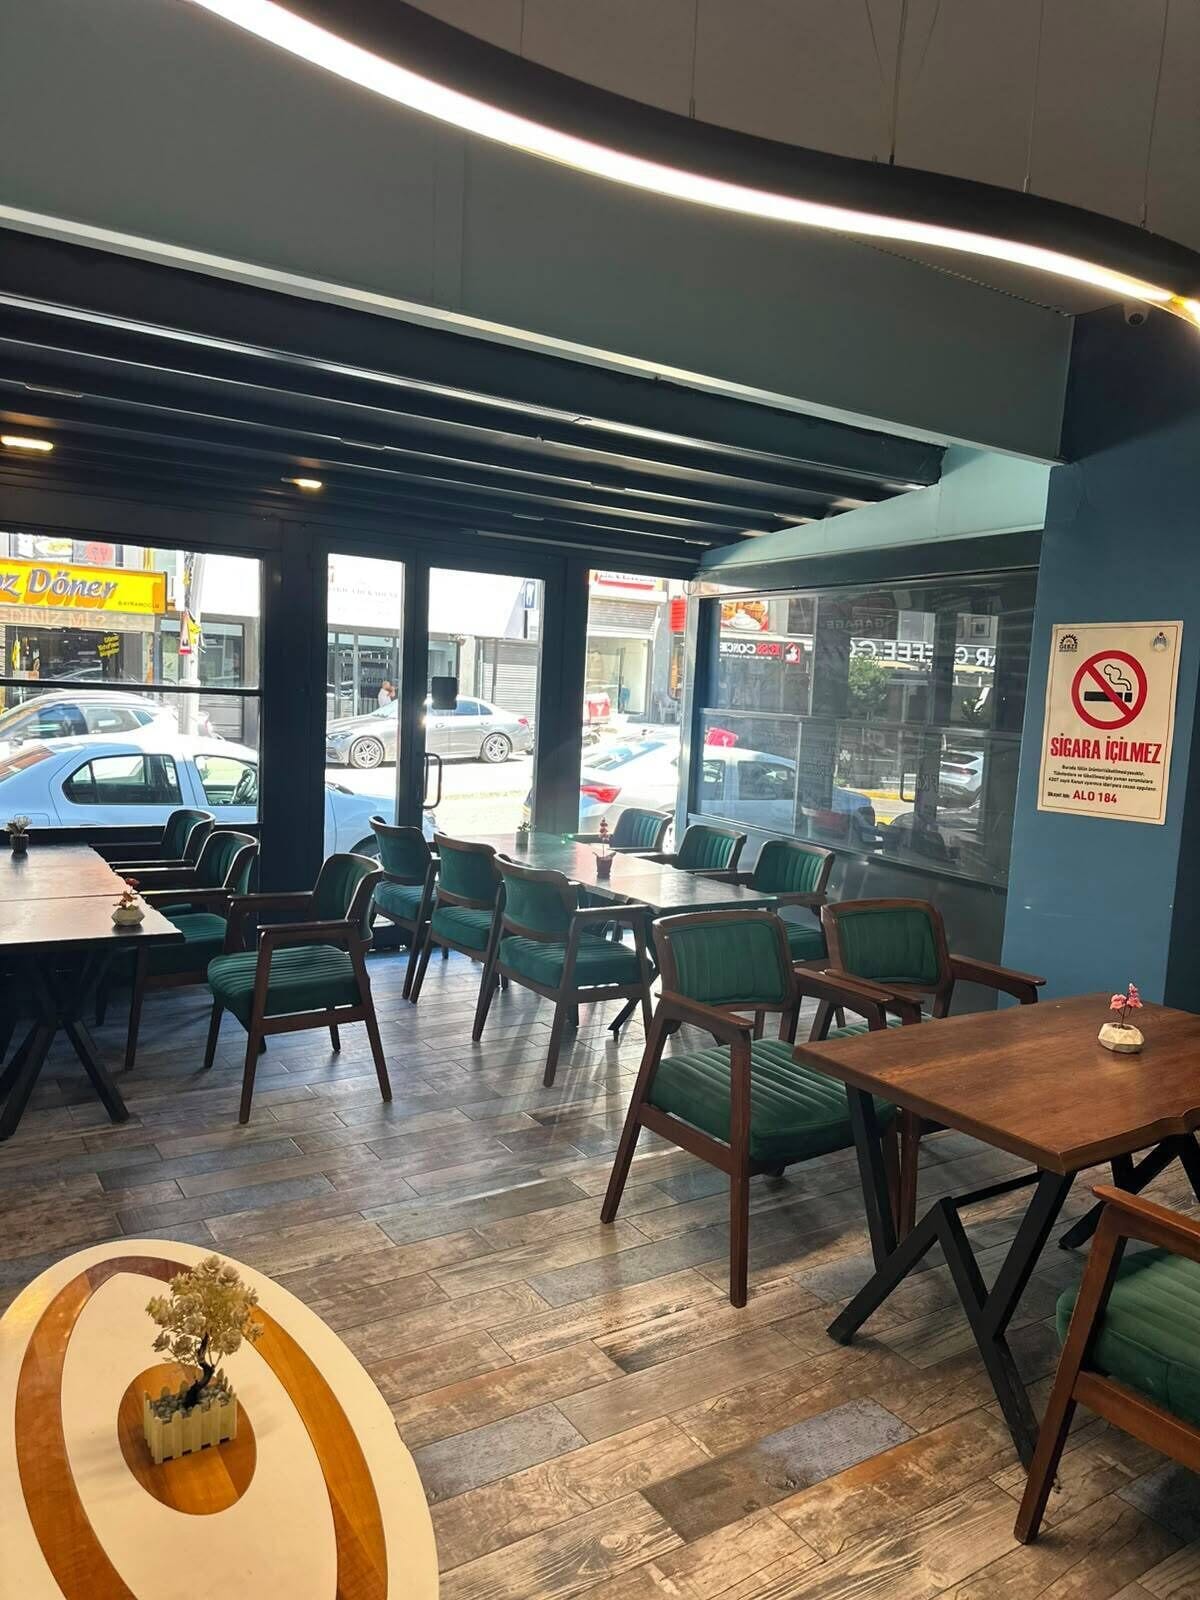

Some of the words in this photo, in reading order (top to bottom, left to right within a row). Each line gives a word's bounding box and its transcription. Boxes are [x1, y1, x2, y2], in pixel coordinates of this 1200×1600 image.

[28, 568, 118, 599] Döner
[1050, 732, 1101, 760] SİGARA
[1105, 735, 1162, 764] İÇİLMEZ
[1072, 790, 1095, 801] ALO
[1098, 792, 1118, 804] 184
